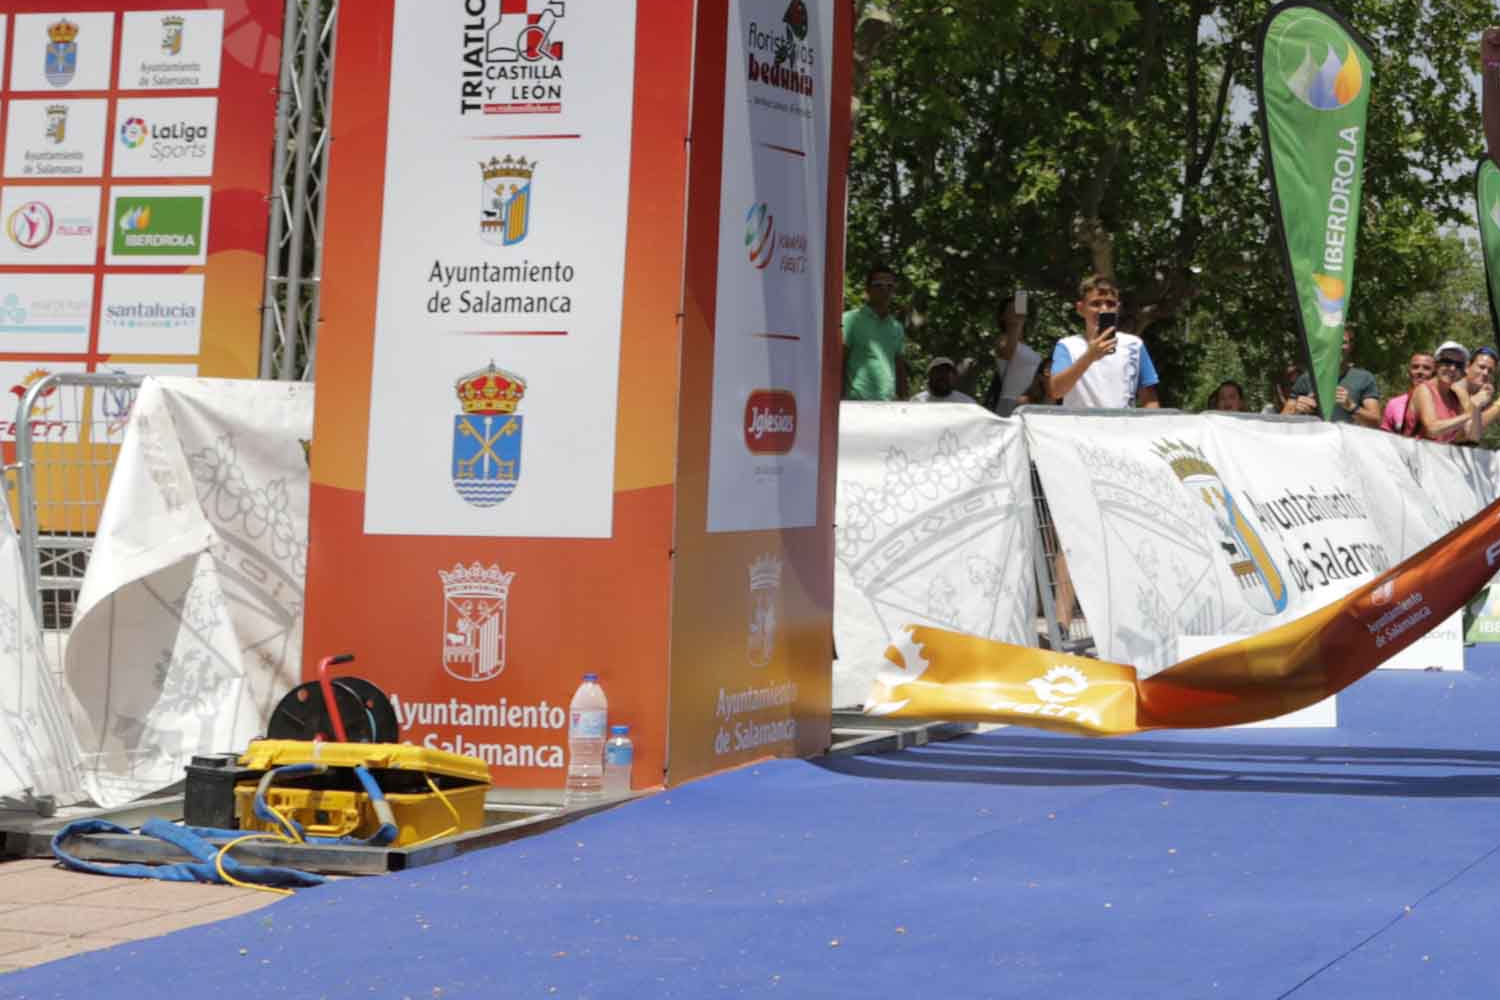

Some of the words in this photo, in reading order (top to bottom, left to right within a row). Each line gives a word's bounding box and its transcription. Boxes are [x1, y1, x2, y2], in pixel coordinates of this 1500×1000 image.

[485, 64, 562, 80] CASTILLA
[485, 86, 496, 101] Y
[511, 81, 562, 100] LEÓN
[151, 121, 208, 143] LaLiga
[1323, 125, 1360, 273] IBERDROLA
[428, 260, 575, 288] Ayuntamiento
[427, 292, 454, 315] de
[459, 290, 573, 315] Salamanca
